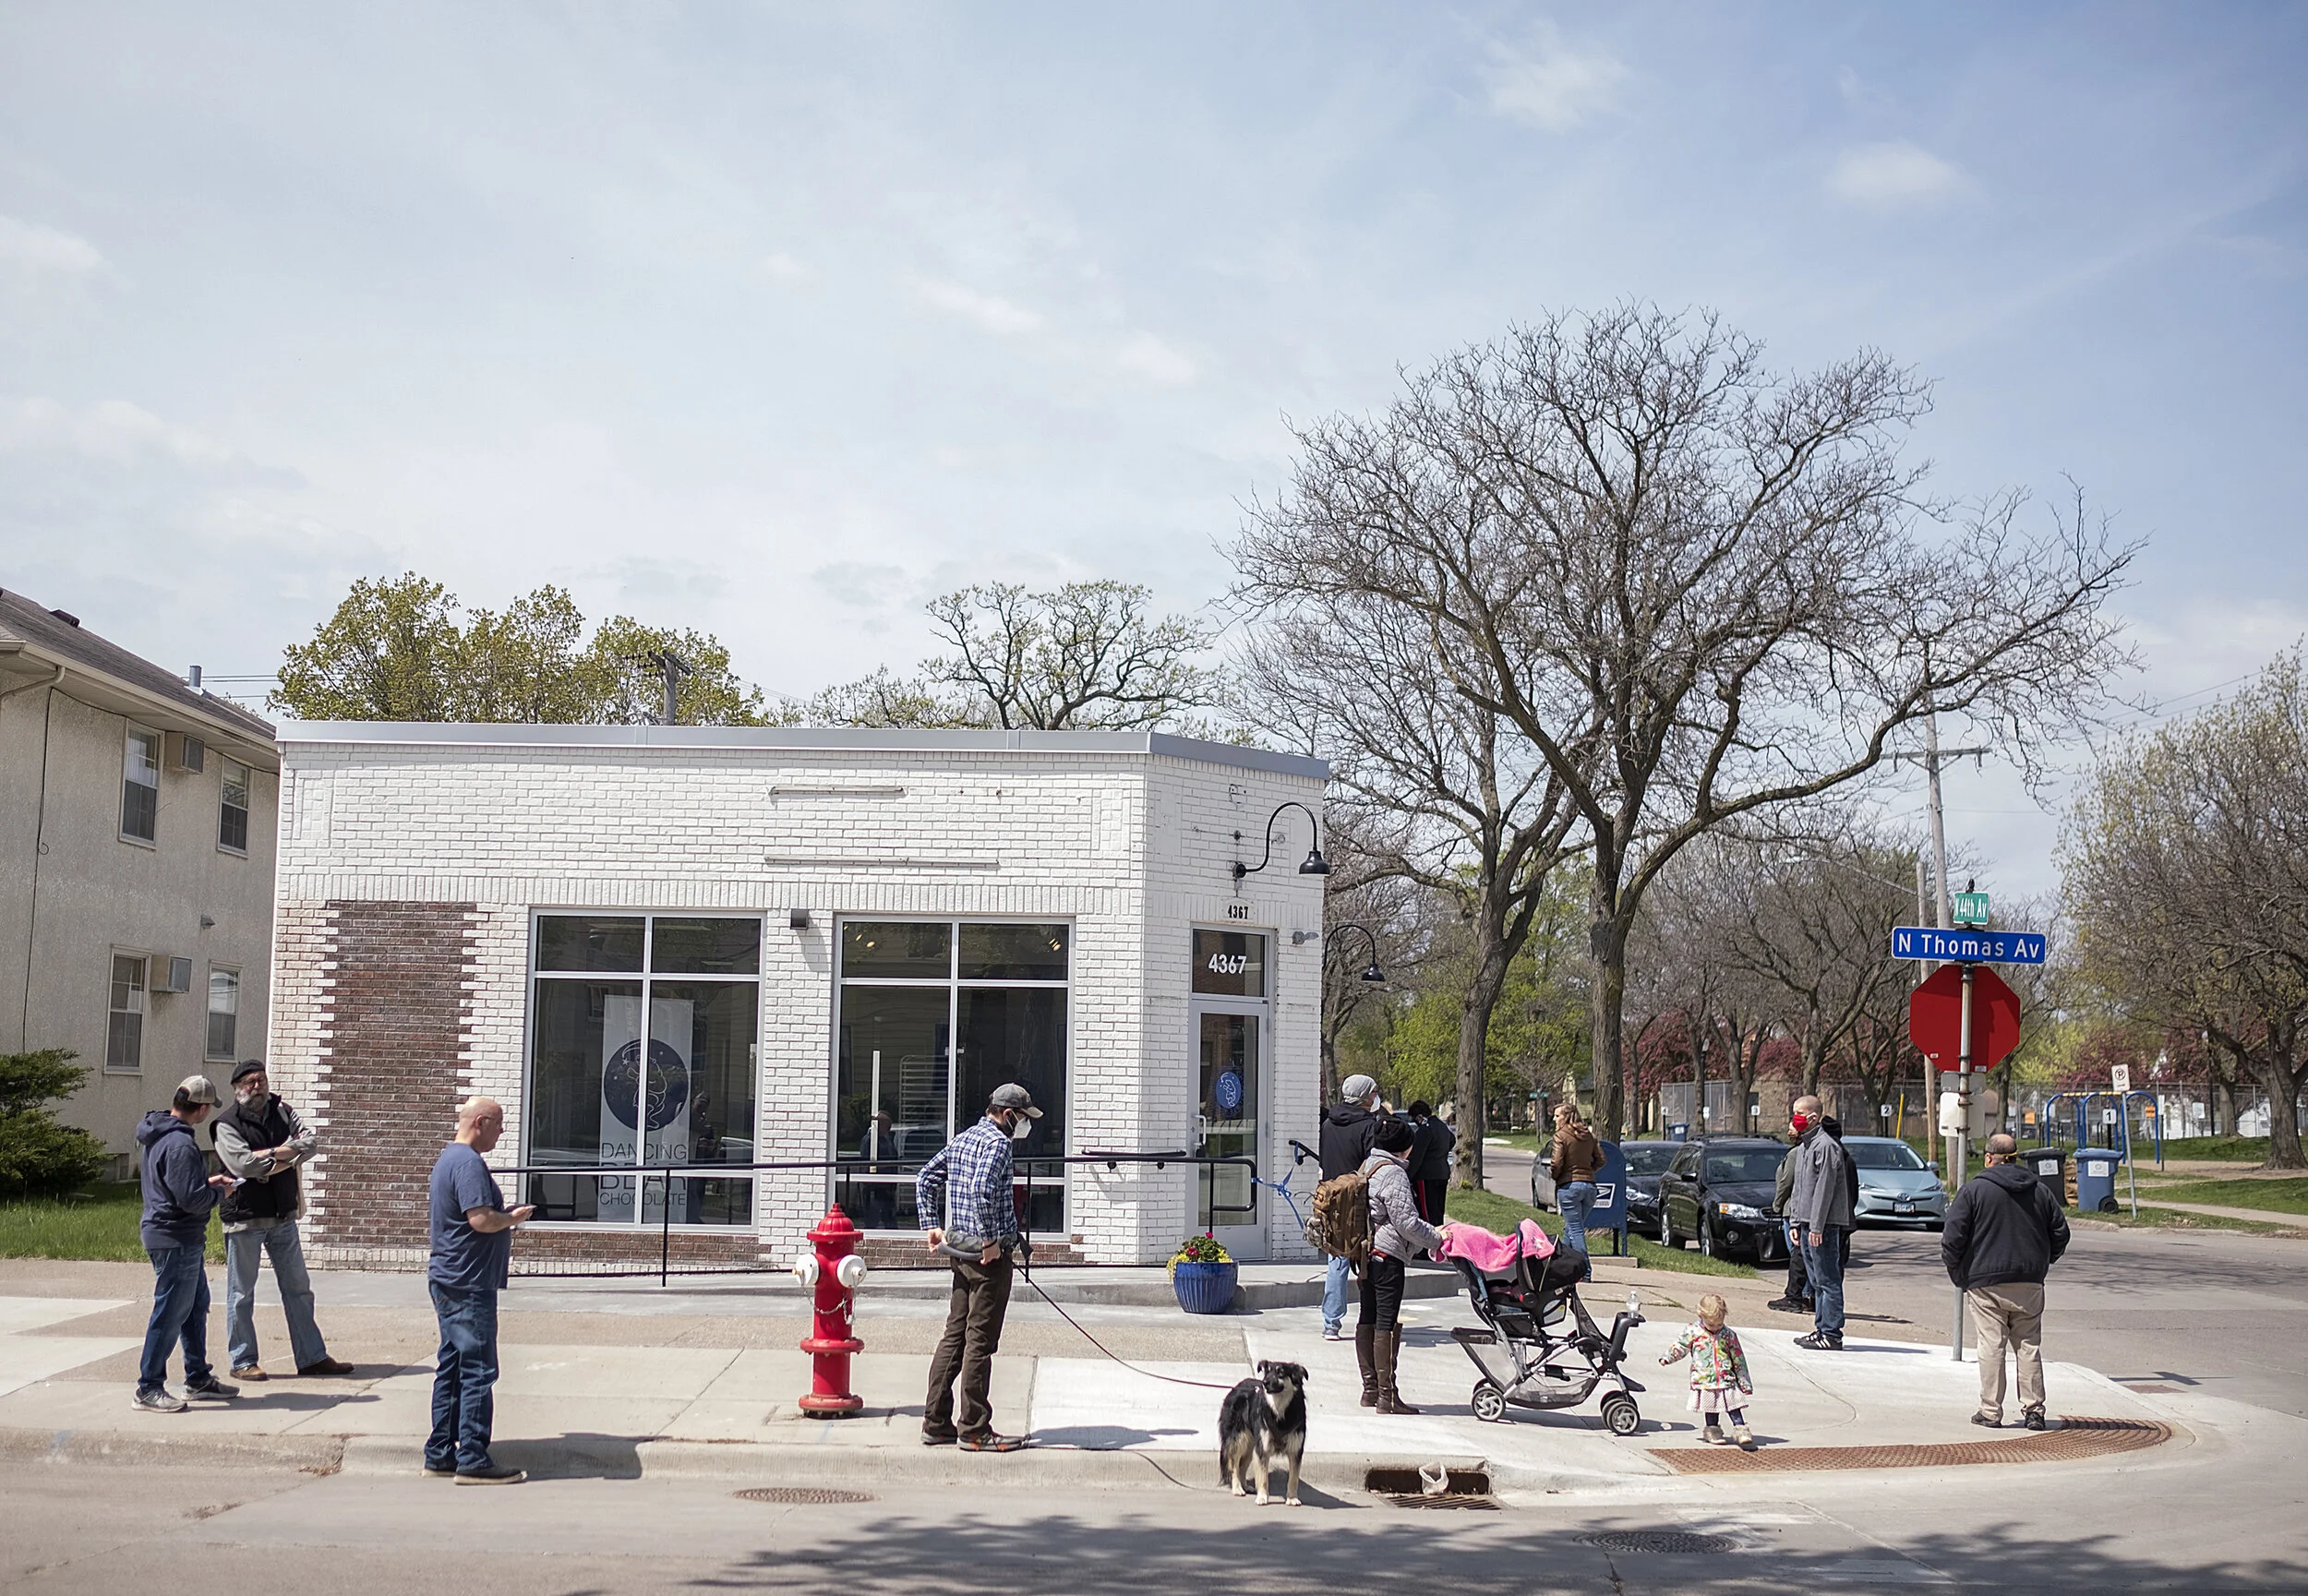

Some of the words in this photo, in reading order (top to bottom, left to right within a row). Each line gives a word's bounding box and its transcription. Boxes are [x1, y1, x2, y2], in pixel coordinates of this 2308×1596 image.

[1228, 905, 1248, 919] 4367
[1960, 897, 1975, 918] 44th
[1976, 898, 1987, 918] Av
[1898, 933, 1911, 953] N
[1921, 934, 2004, 956] Thomas
[2013, 938, 2039, 958] Av
[1208, 953, 1247, 975] 4367
[2106, 1111, 2111, 1122] 1
[601, 1142, 687, 1160] DANCING
